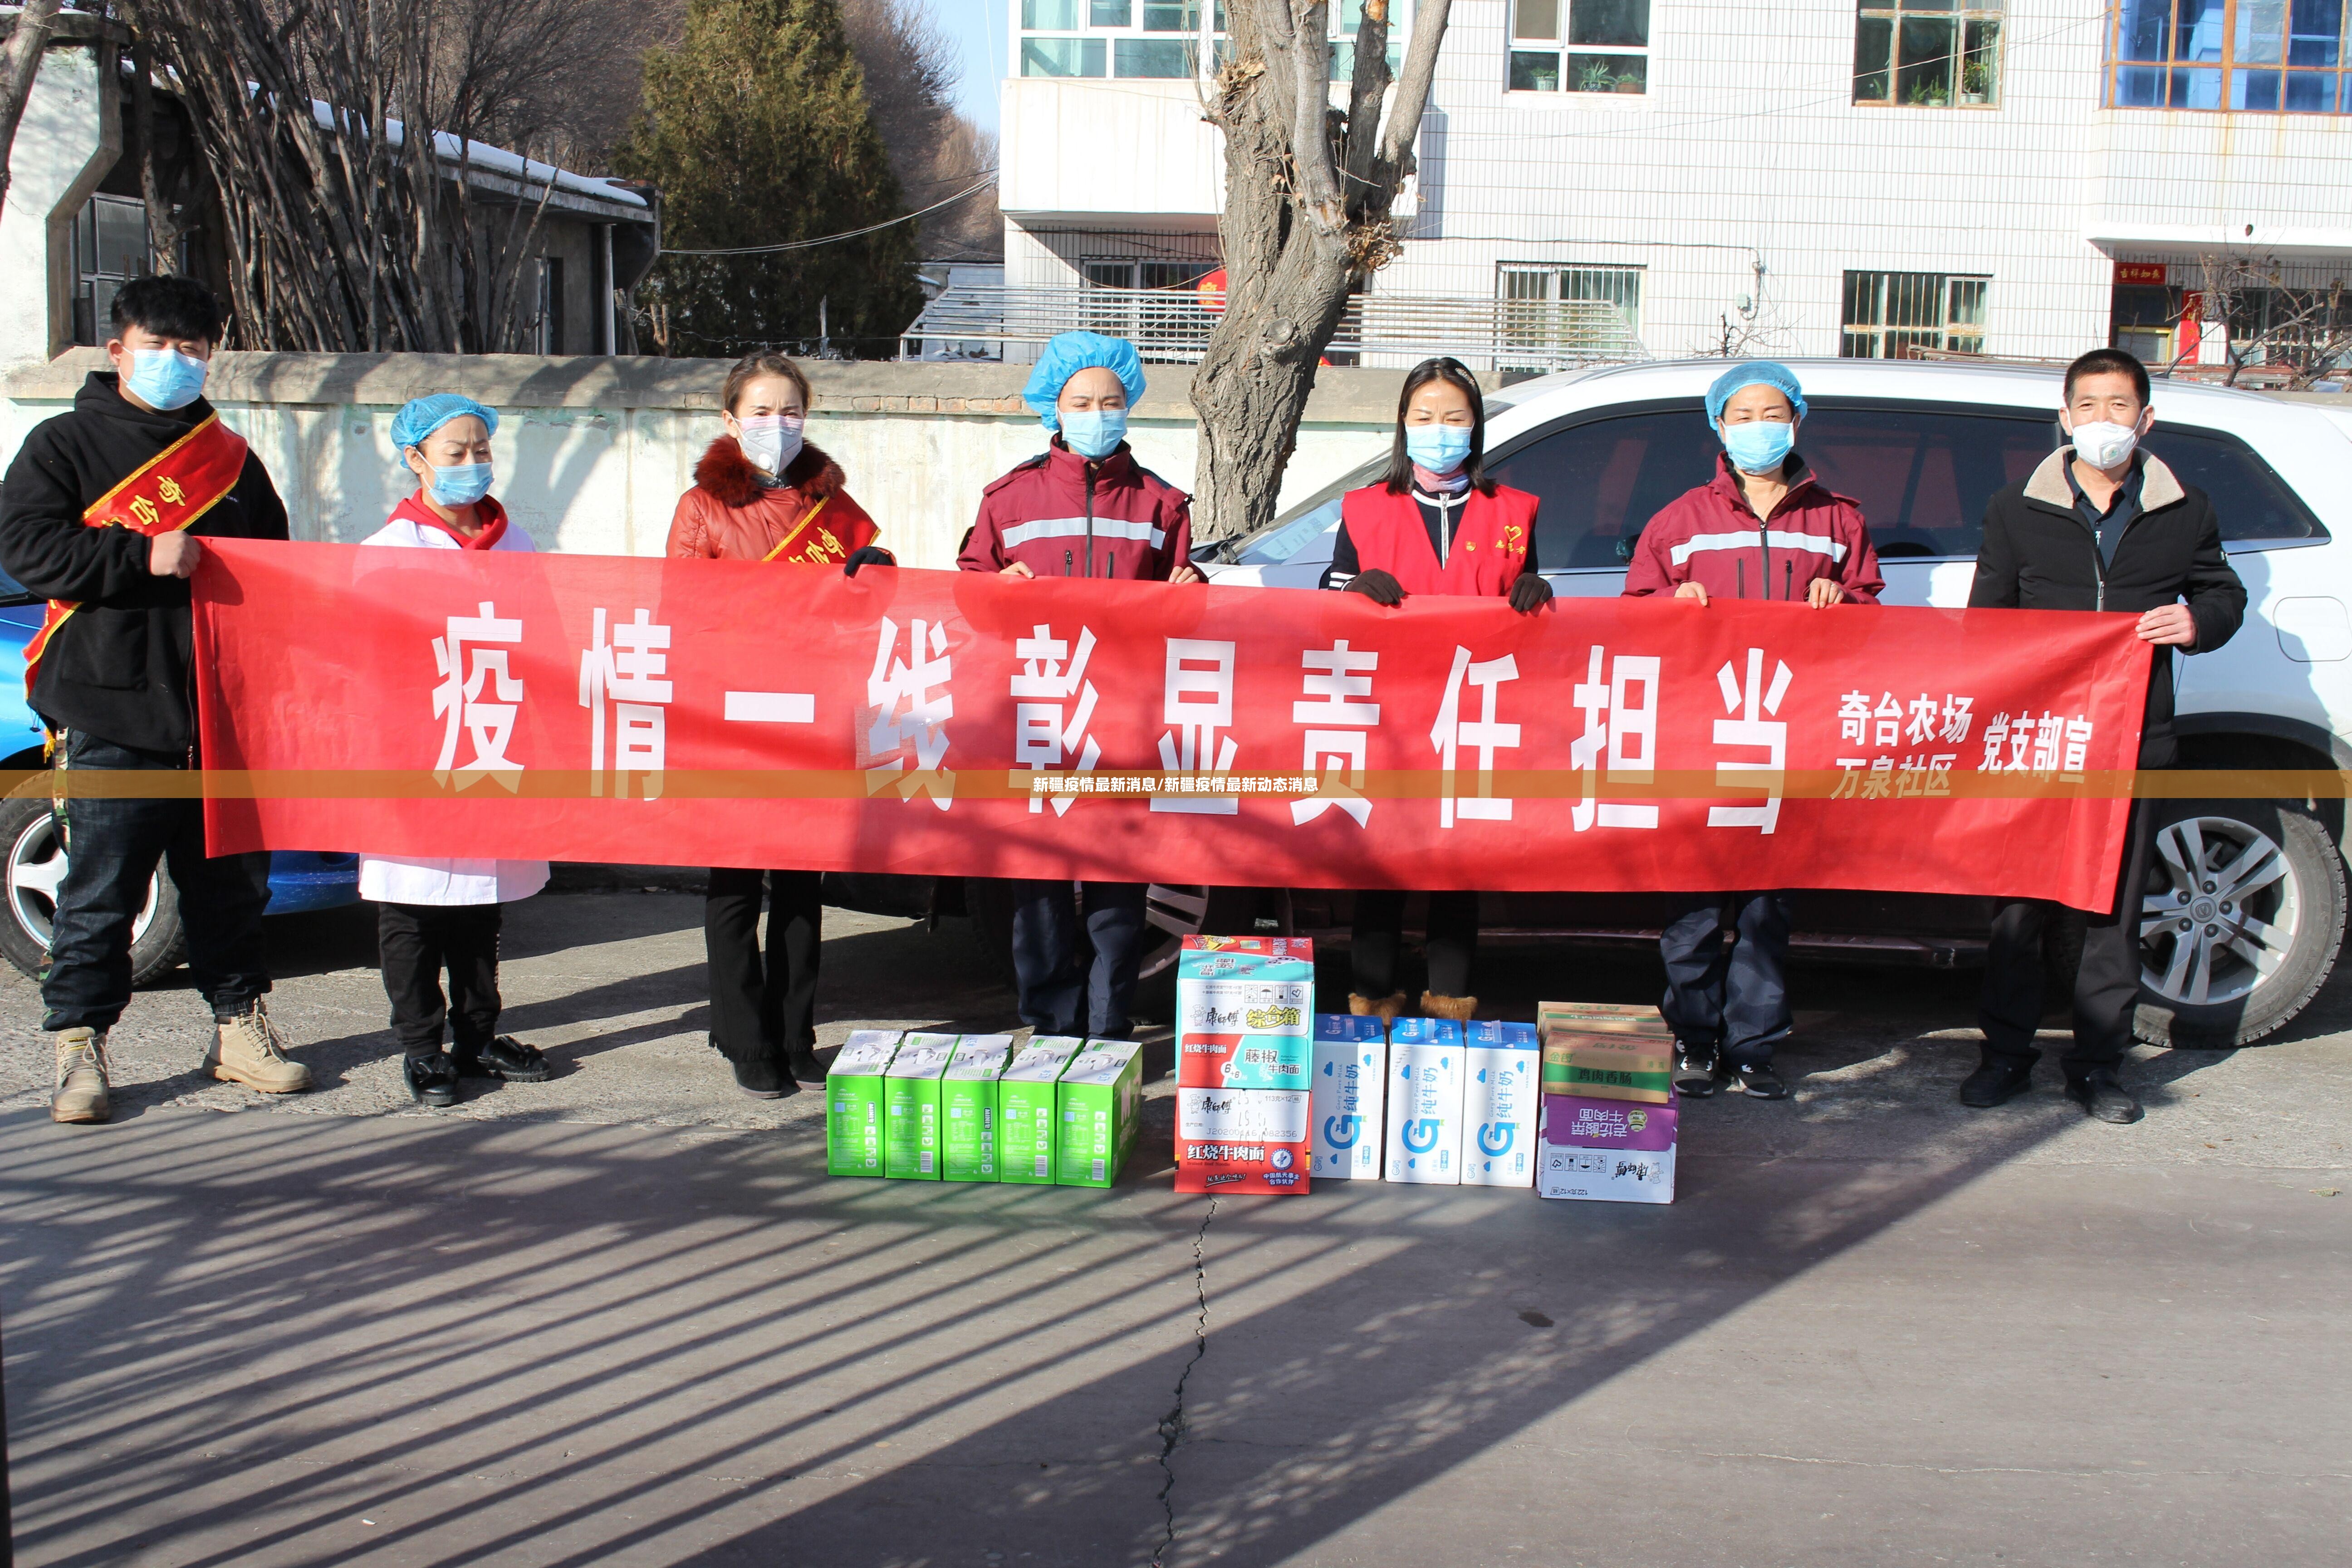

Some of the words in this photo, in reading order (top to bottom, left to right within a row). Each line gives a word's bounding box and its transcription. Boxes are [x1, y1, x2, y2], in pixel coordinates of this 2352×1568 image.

[2120, 269, 2160, 279] 吉祥如意
[102, 475, 186, 525] 奇台
[431, 601, 1793, 835] 疫情一线彰显责任担当
[1838, 690, 1974, 746] 奇台农场
[1977, 710, 2092, 784] 党支部宣
[1830, 753, 1957, 800] 万泉社区
[1246, 1005, 1301, 1029] 综合箱
[1185, 1044, 1227, 1054] 红烧牛肉面
[1245, 1049, 1279, 1063] 藤椒
[1549, 1052, 1573, 1063] 金锣
[1268, 1064, 1300, 1074] 牛肉面
[1578, 1068, 1632, 1085] 鸡肉香肠
[1344, 1064, 1361, 1112] 纯牛奶
[1421, 1067, 1438, 1115] 纯牛奶
[1496, 1071, 1514, 1118] 纯牛奶
[1579, 1108, 1623, 1123] 牛肉面
[1571, 1121, 1628, 1137] 老坛酸菜
[1187, 1144, 1265, 1161] 红烧牛肉面
